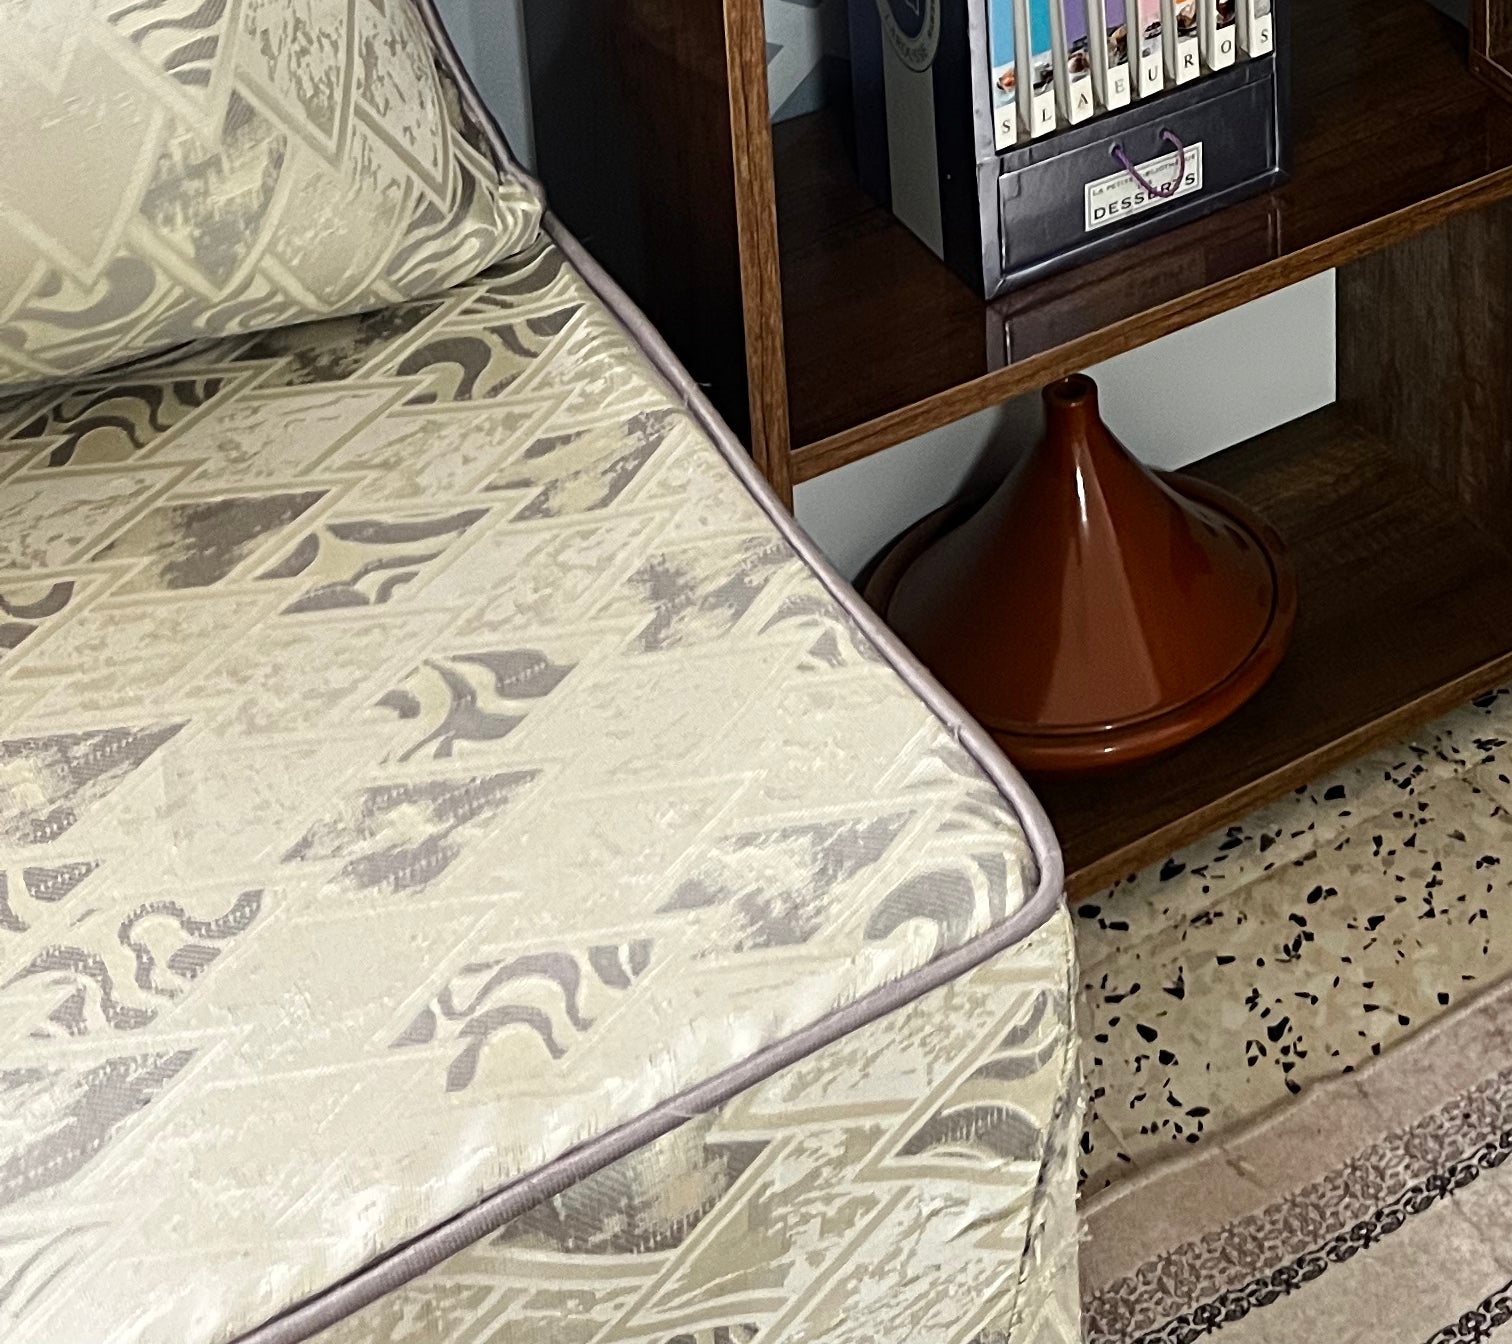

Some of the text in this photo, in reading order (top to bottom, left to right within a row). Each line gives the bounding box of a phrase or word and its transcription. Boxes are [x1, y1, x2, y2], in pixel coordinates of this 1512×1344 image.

[1260, 28, 1270, 44] S
[1219, 39, 1232, 55] O
[1183, 53, 1195, 69] R
[1147, 66, 1159, 82] U
[1114, 77, 1126, 94] E
[1076, 93, 1089, 109] A
[1041, 107, 1052, 123] L
[1001, 118, 1012, 134] S
[1092, 187, 1104, 197] LA
